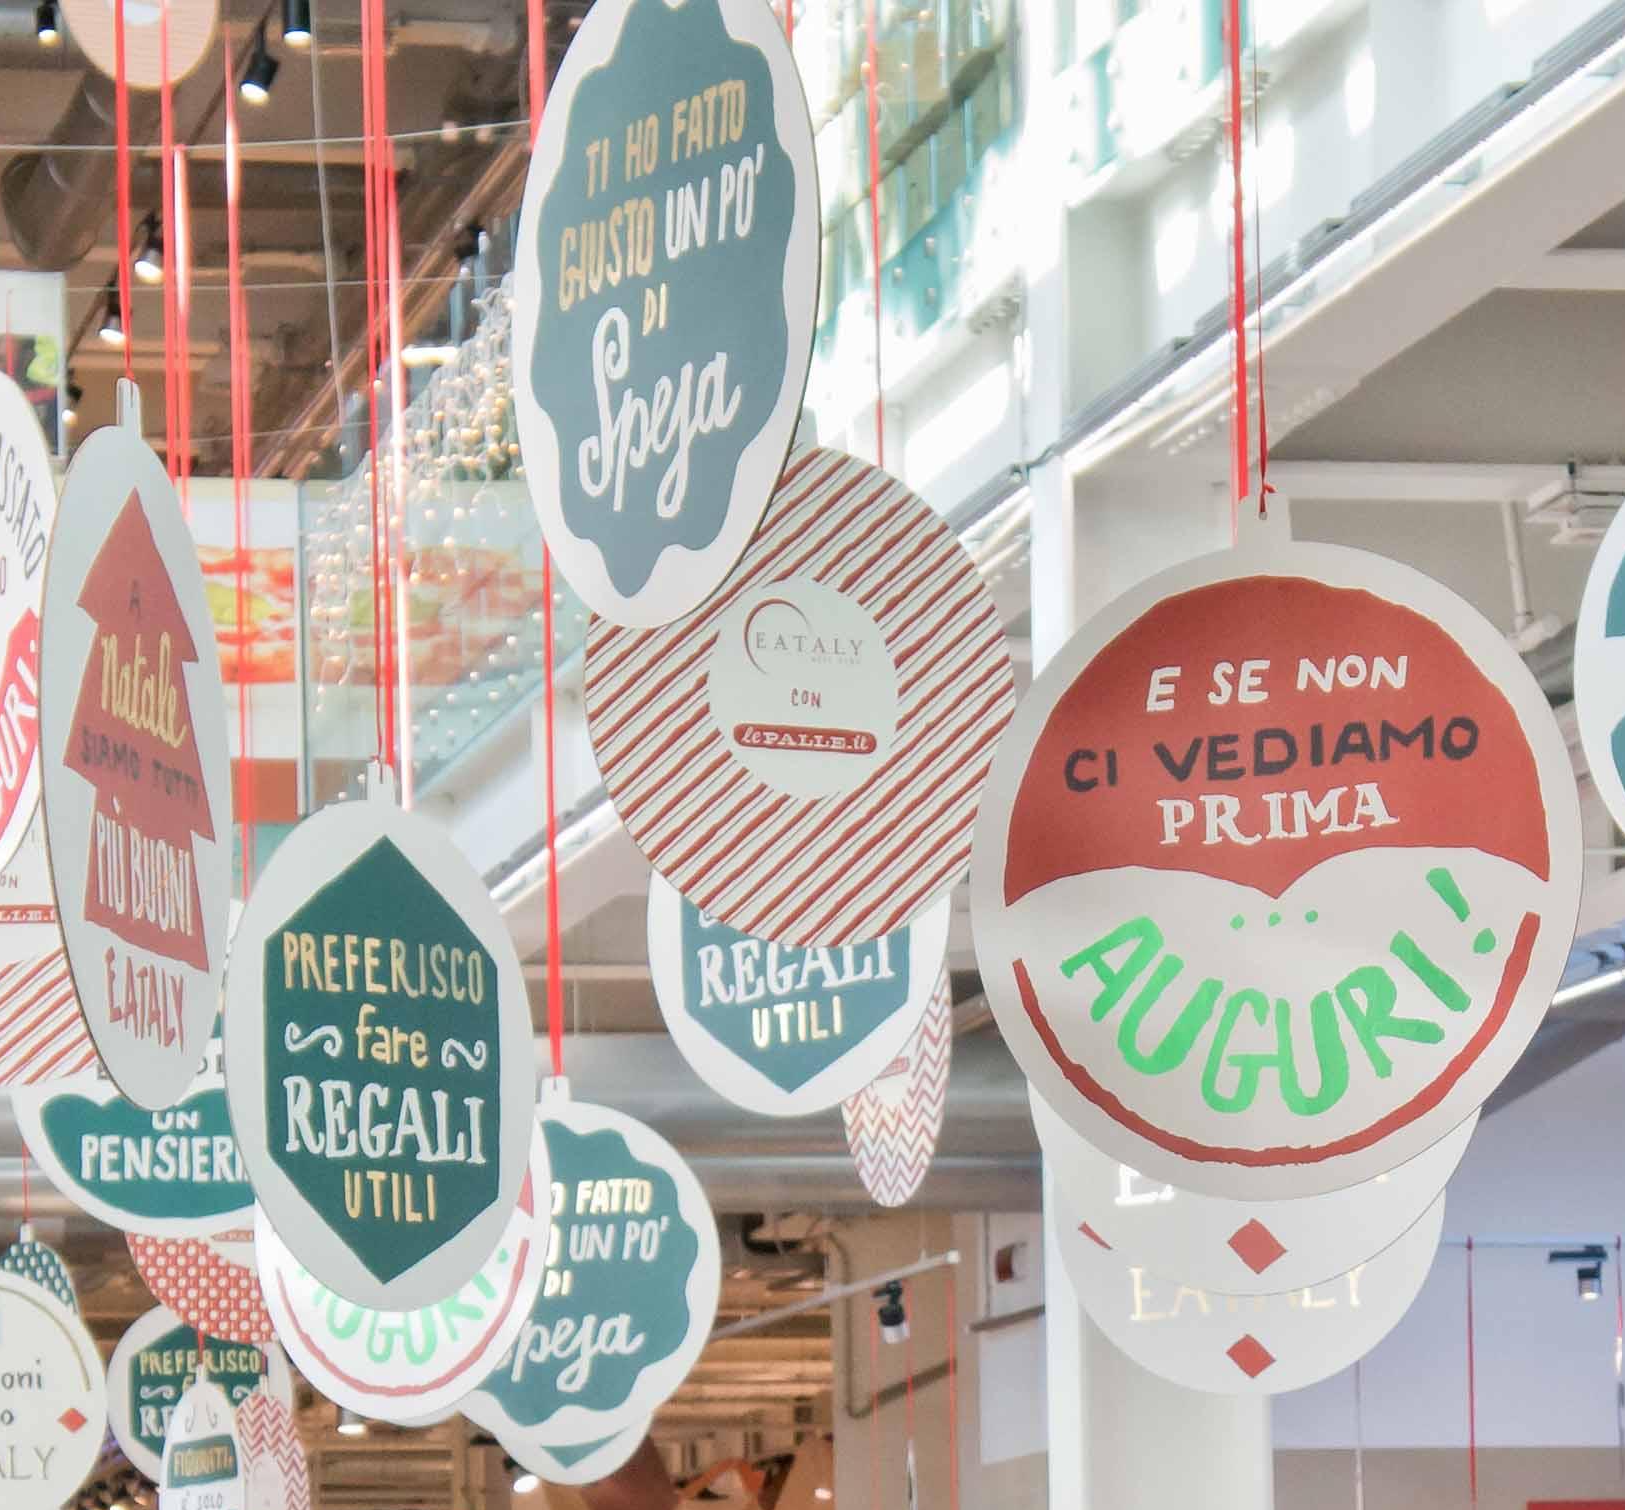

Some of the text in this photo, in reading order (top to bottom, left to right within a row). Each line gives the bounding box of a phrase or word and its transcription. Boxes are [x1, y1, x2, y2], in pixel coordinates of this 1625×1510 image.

[586, 80, 747, 198] TI HO FATTO
[559, 197, 655, 311] GIUSTO
[664, 182, 710, 259] UN
[643, 283, 669, 336] DI
[129, 580, 140, 621] A
[756, 631, 863, 656] EATALY
[791, 687, 822, 708] CON
[1145, 654, 1409, 713] E SE NON
[79, 724, 199, 808] SIAMO TUTTI
[741, 725, 870, 751] lePALLE.it
[1064, 714, 1480, 793] CI VEDIAMO
[1156, 781, 1400, 847] PRIMA
[129, 823, 194, 937] BUONI
[283, 930, 485, 1005] PREFERISCO
[697, 926, 897, 1008] REGALI
[1060, 866, 1497, 1116] AUGURI!
[104, 943, 186, 1055] EATALY
[750, 993, 842, 1050] UTILI
[355, 1003, 429, 1068] fare
[151, 1110, 201, 1132] UN
[282, 1075, 487, 1165] REGALI
[80, 1133, 251, 1183] PENSIERI
[343, 1168, 436, 1222] UTILI
[576, 1178, 652, 1216] FATTO
[569, 1222, 614, 1263] UN
[544, 1270, 572, 1297] DI
